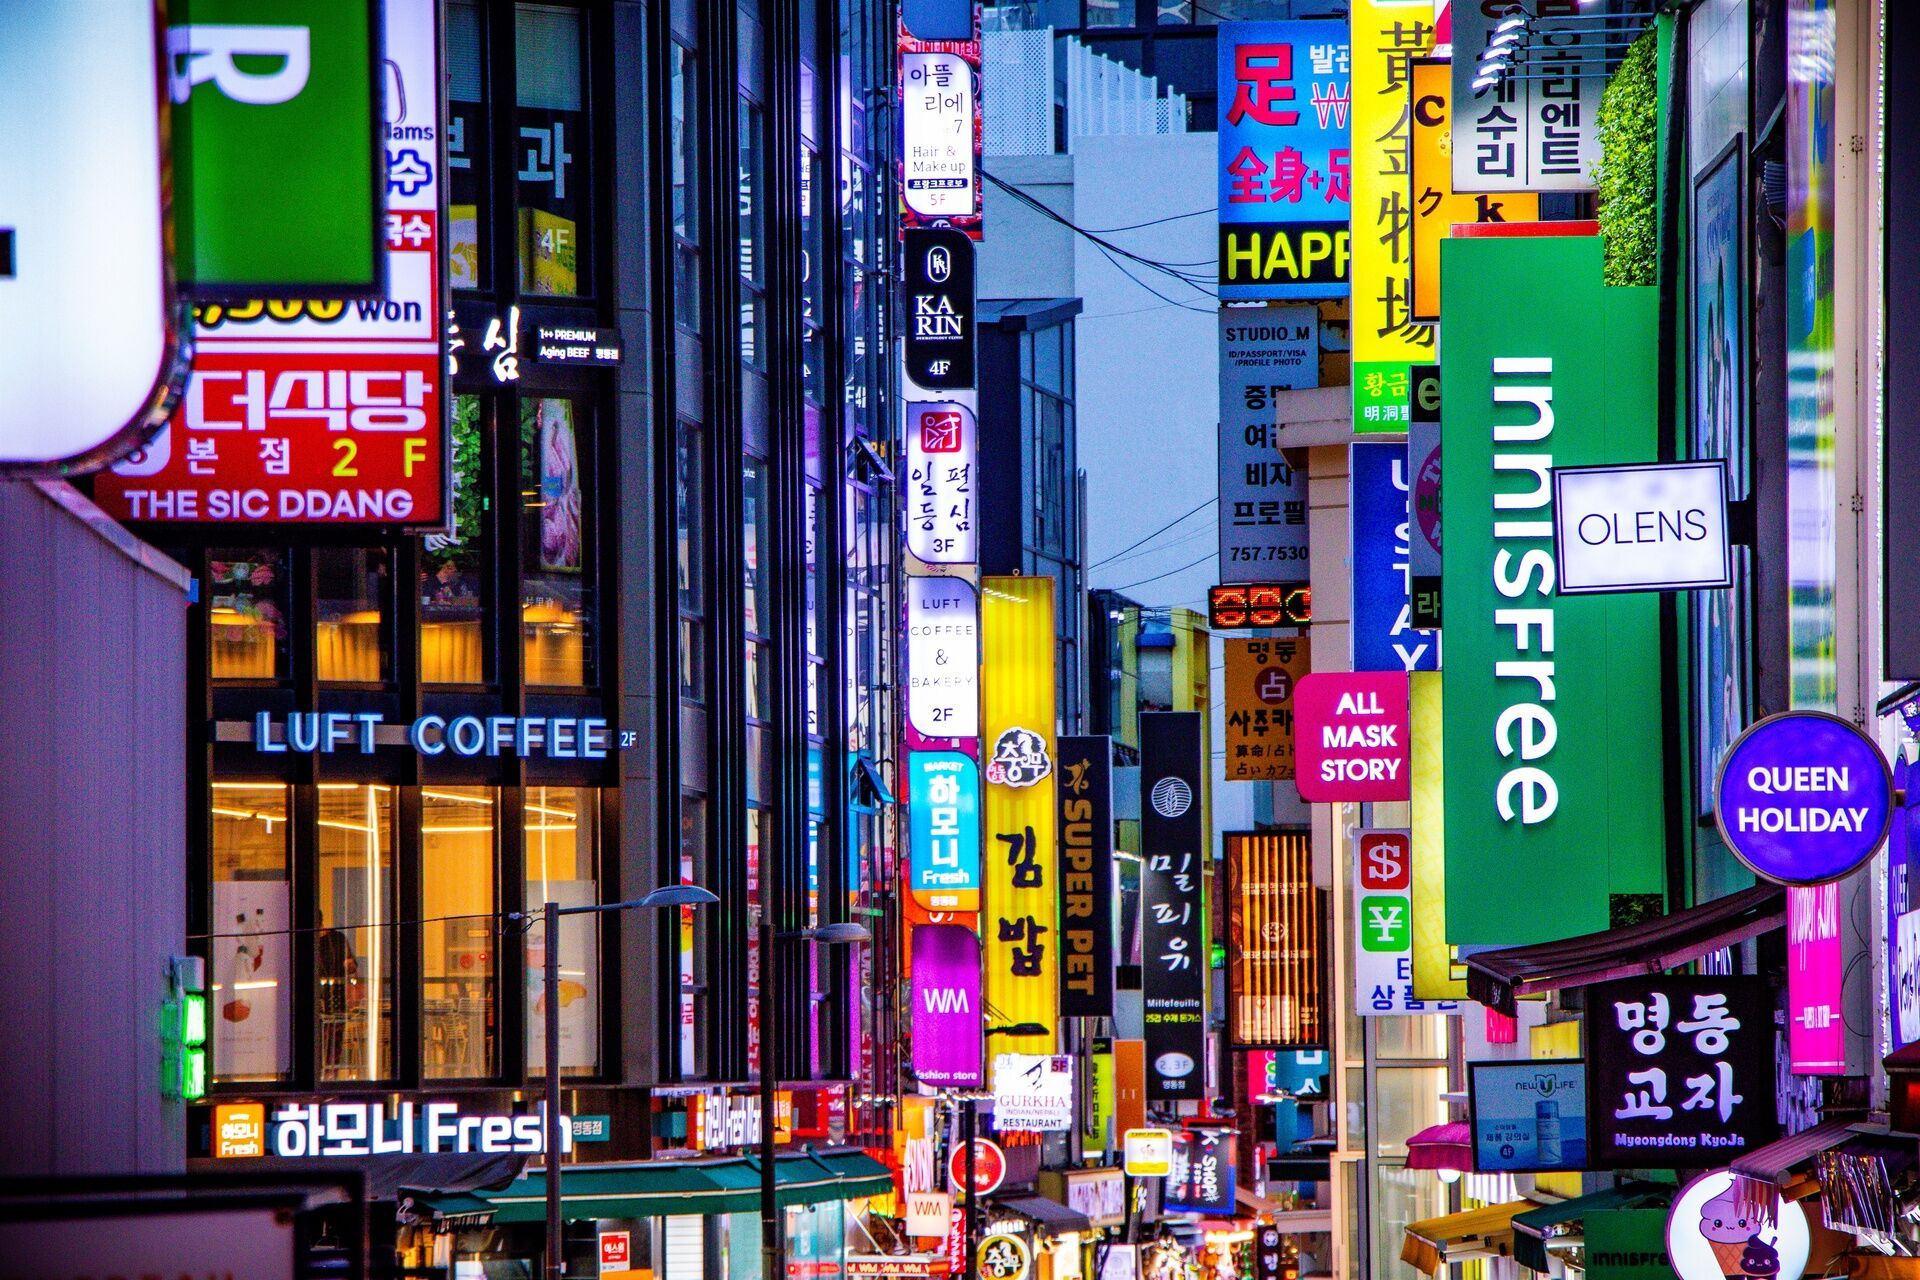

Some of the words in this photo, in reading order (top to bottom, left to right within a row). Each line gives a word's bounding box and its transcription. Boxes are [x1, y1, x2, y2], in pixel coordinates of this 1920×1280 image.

[168, 25, 311, 105] R
[1226, 43, 1301, 127] 足
[953, 119, 963, 134] 7
[912, 146, 939, 158] Hair
[930, 193, 946, 206] 5F
[540, 229, 569, 254] 4F
[555, 329, 596, 342] PREMIUM
[539, 345, 565, 360] Aging
[566, 347, 590, 359] BEEF
[930, 360, 951, 375] 4F
[185, 370, 433, 432] 더식당
[123, 489, 198, 518] THE
[208, 489, 269, 518] SIC
[279, 489, 414, 518] DDANG
[1577, 508, 1708, 546] OLENS
[932, 538, 955, 553] 3F
[922, 598, 961, 609] LUFT
[910, 625, 973, 636] COFFEE
[935, 648, 949, 666] &
[911, 676, 973, 688] BAKERY
[932, 707, 953, 722] 2F
[1336, 692, 1385, 716] ALL
[256, 710, 384, 754] LUFT
[411, 715, 608, 758] COFFEE
[620, 731, 637, 747] 2F
[1321, 724, 1398, 749] MASK
[1319, 758, 1402, 782] STORY
[1747, 766, 1849, 795] QUEEN
[929, 774, 961, 868] 하모니
[1738, 807, 1870, 833] HOLIDAY
[1063, 799, 1095, 919] SUPER
[922, 868, 970, 885] Fresh
[996, 825, 1048, 977] 김밥
[1066, 929, 1096, 997] PET
[923, 988, 970, 1014] WM
[1146, 999, 1201, 1008] Millefeuille
[1614, 992, 1742, 1055] 명동
[915, 1069, 950, 1081] fashion
[952, 1070, 977, 1081] store
[1051, 1060, 1068, 1073] 5F
[999, 1094, 1066, 1108] GURKHA
[1614, 1061, 1744, 1123] 교자
[275, 1102, 413, 1157] 하모니
[424, 1099, 573, 1154] Fresh
[1002, 1117, 1063, 1128] RESTAURANT
[221, 1141, 258, 1155] Fresh
[1614, 1133, 1697, 1147] Myeongdong
[1700, 1133, 1745, 1146] KyoJa
